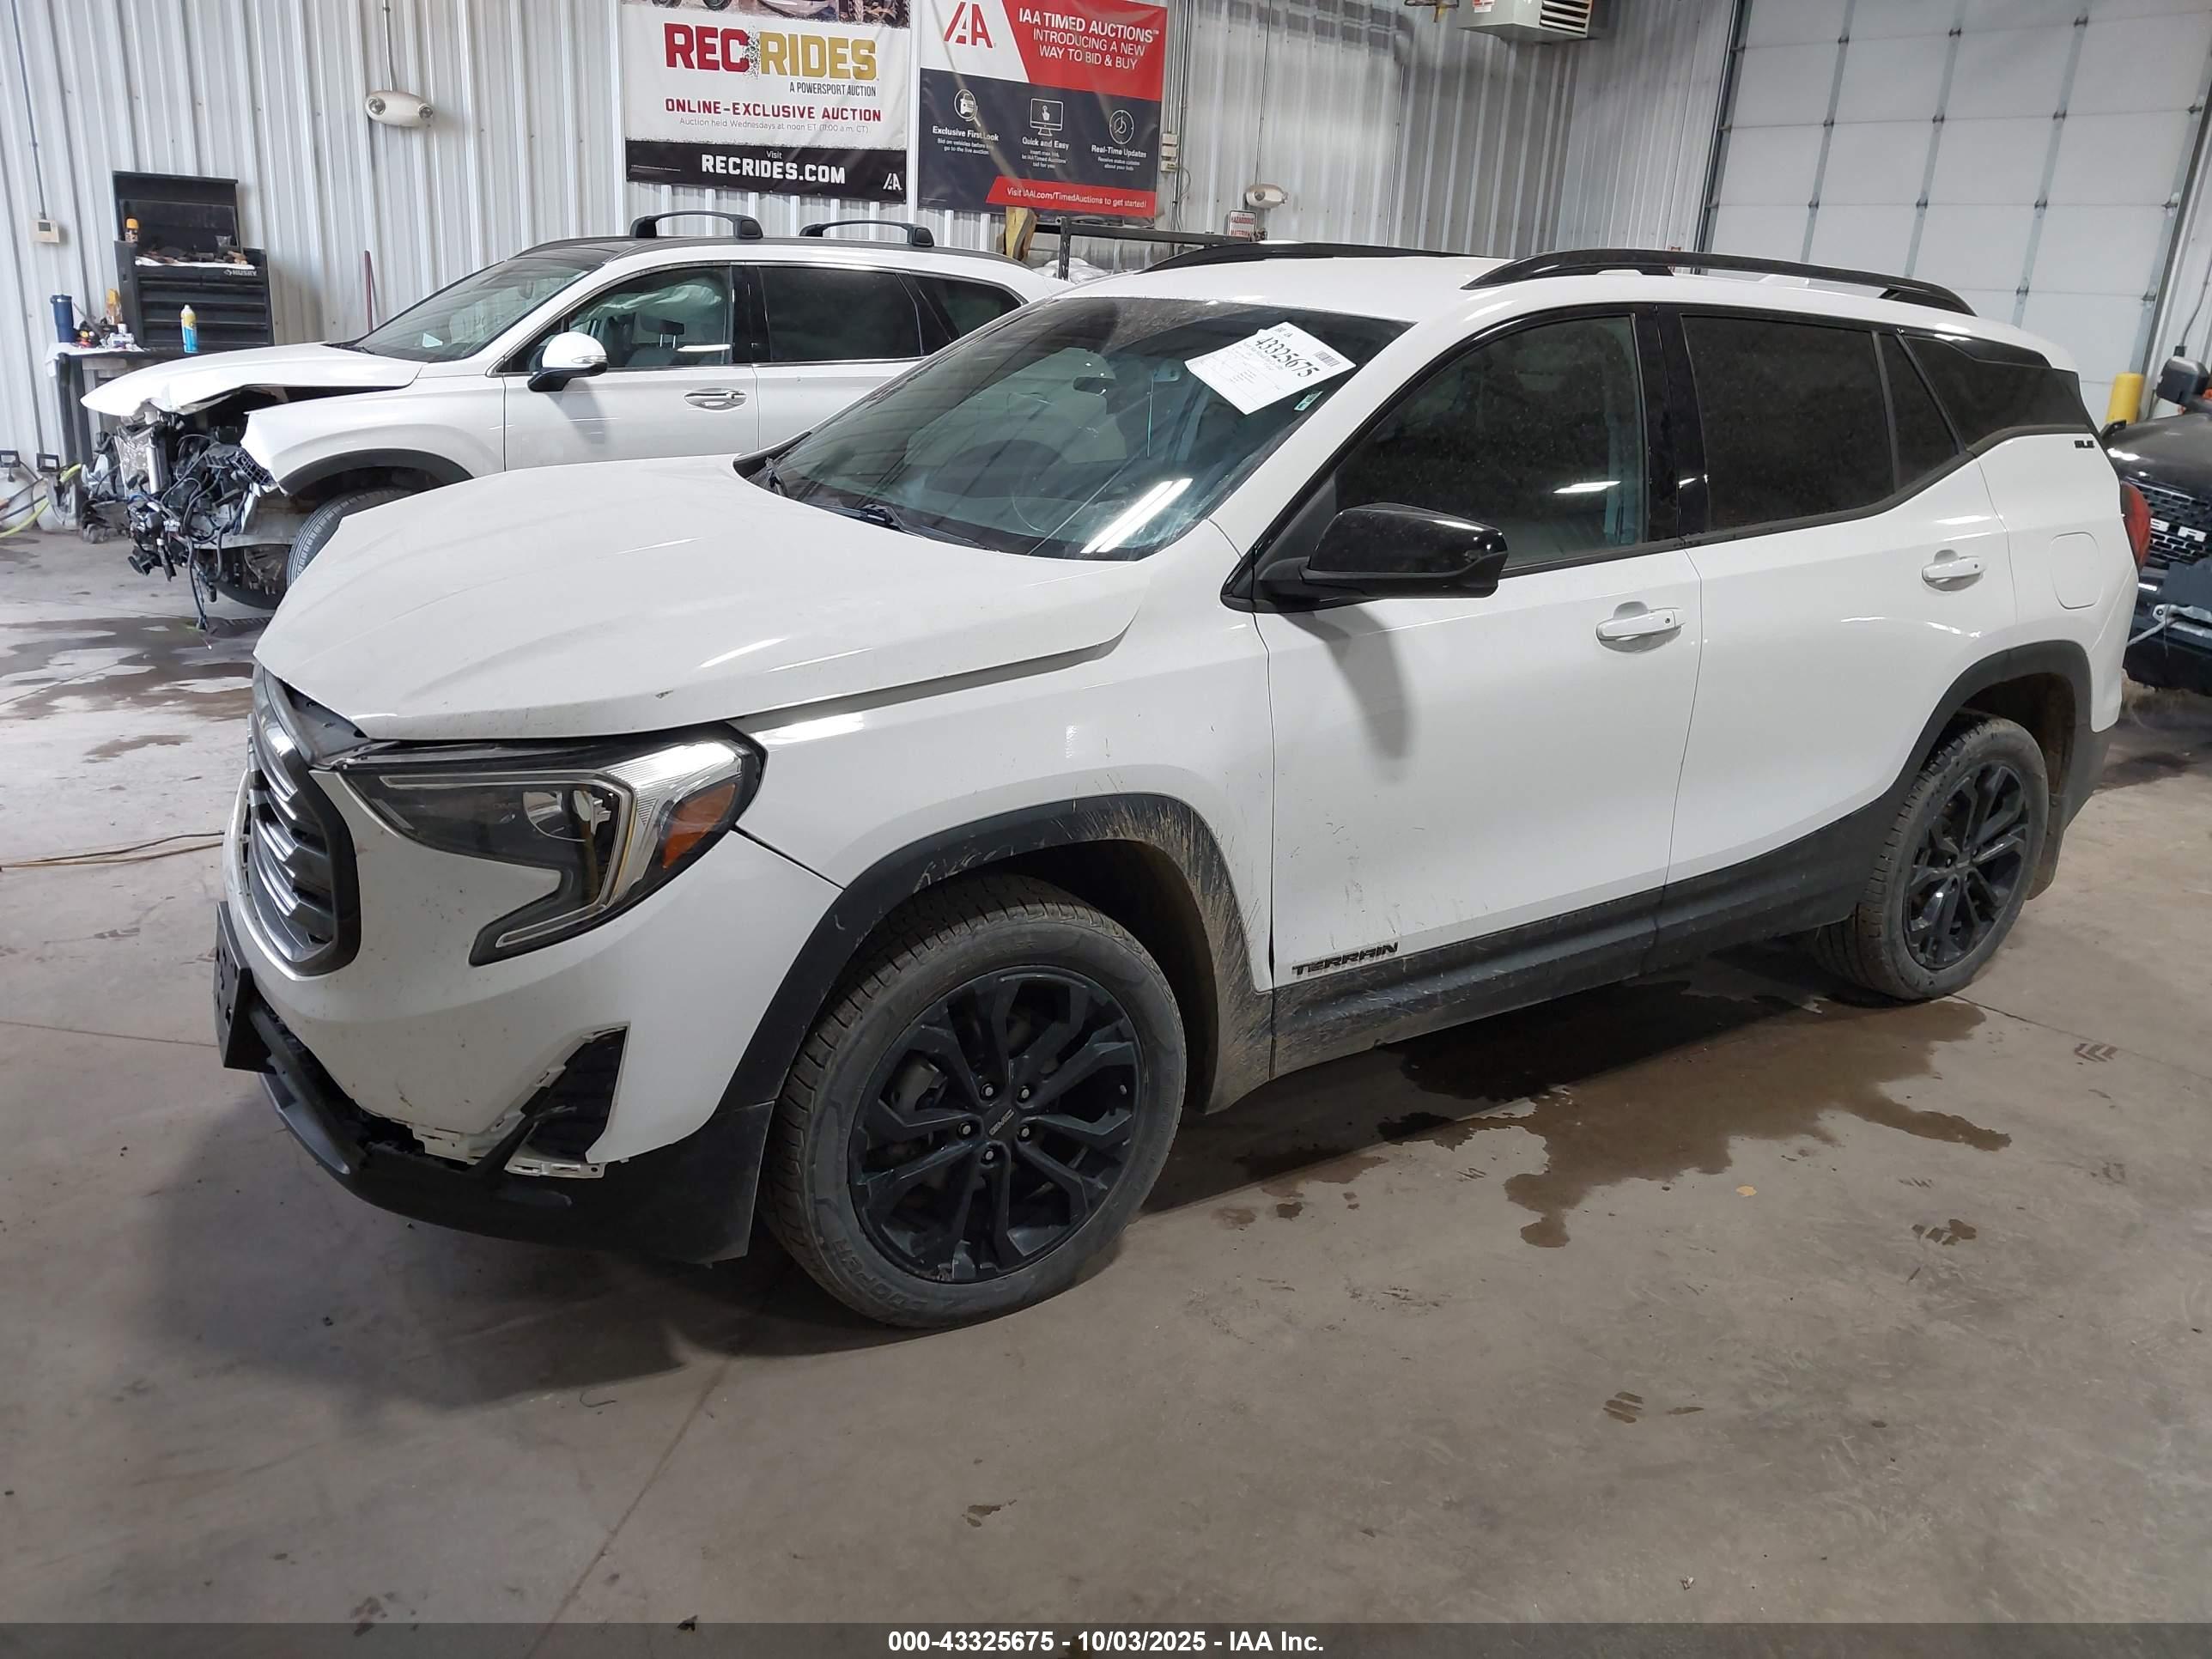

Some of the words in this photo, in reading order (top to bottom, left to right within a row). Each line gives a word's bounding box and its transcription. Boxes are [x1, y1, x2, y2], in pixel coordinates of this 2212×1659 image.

[1018, 7, 1042, 26] IAA
[1043, 12, 1086, 33] TIMED
[1033, 27, 1108, 51] INTRODUCING
[1109, 41, 1117, 52] A
[1121, 43, 1146, 57] NEW
[1039, 44, 1066, 59] WAY
[1066, 48, 1083, 62] TO
[1085, 52, 1102, 65] BID
[1103, 54, 1113, 67] &
[1115, 56, 1138, 70] BUY
[789, 82, 796, 93] A
[796, 82, 846, 95] POWERSPORT
[847, 84, 877, 97] AUCTION
[822, 106, 882, 122] AUCTION
[679, 118, 709, 128] Auction
[711, 118, 727, 128] held
[730, 119, 775, 131] Wednesdays
[932, 125, 966, 137] Exclusive
[967, 130, 982, 139] First
[1022, 136, 1039, 146] Quick
[1040, 139, 1053, 148] and
[1054, 140, 1070, 150] Easy
[1091, 144, 1123, 155] Real-Time
[1123, 148, 1147, 158] Updates
[766, 150, 782, 160] Visit
[701, 154, 846, 185] RECRIDES.COM
[1006, 186, 1022, 197] Visit
[1104, 197, 1112, 206] to
[1112, 198, 1123, 208] get
[1255, 337, 1321, 378] 43325675
[1291, 941, 1399, 976] TERRAIN
